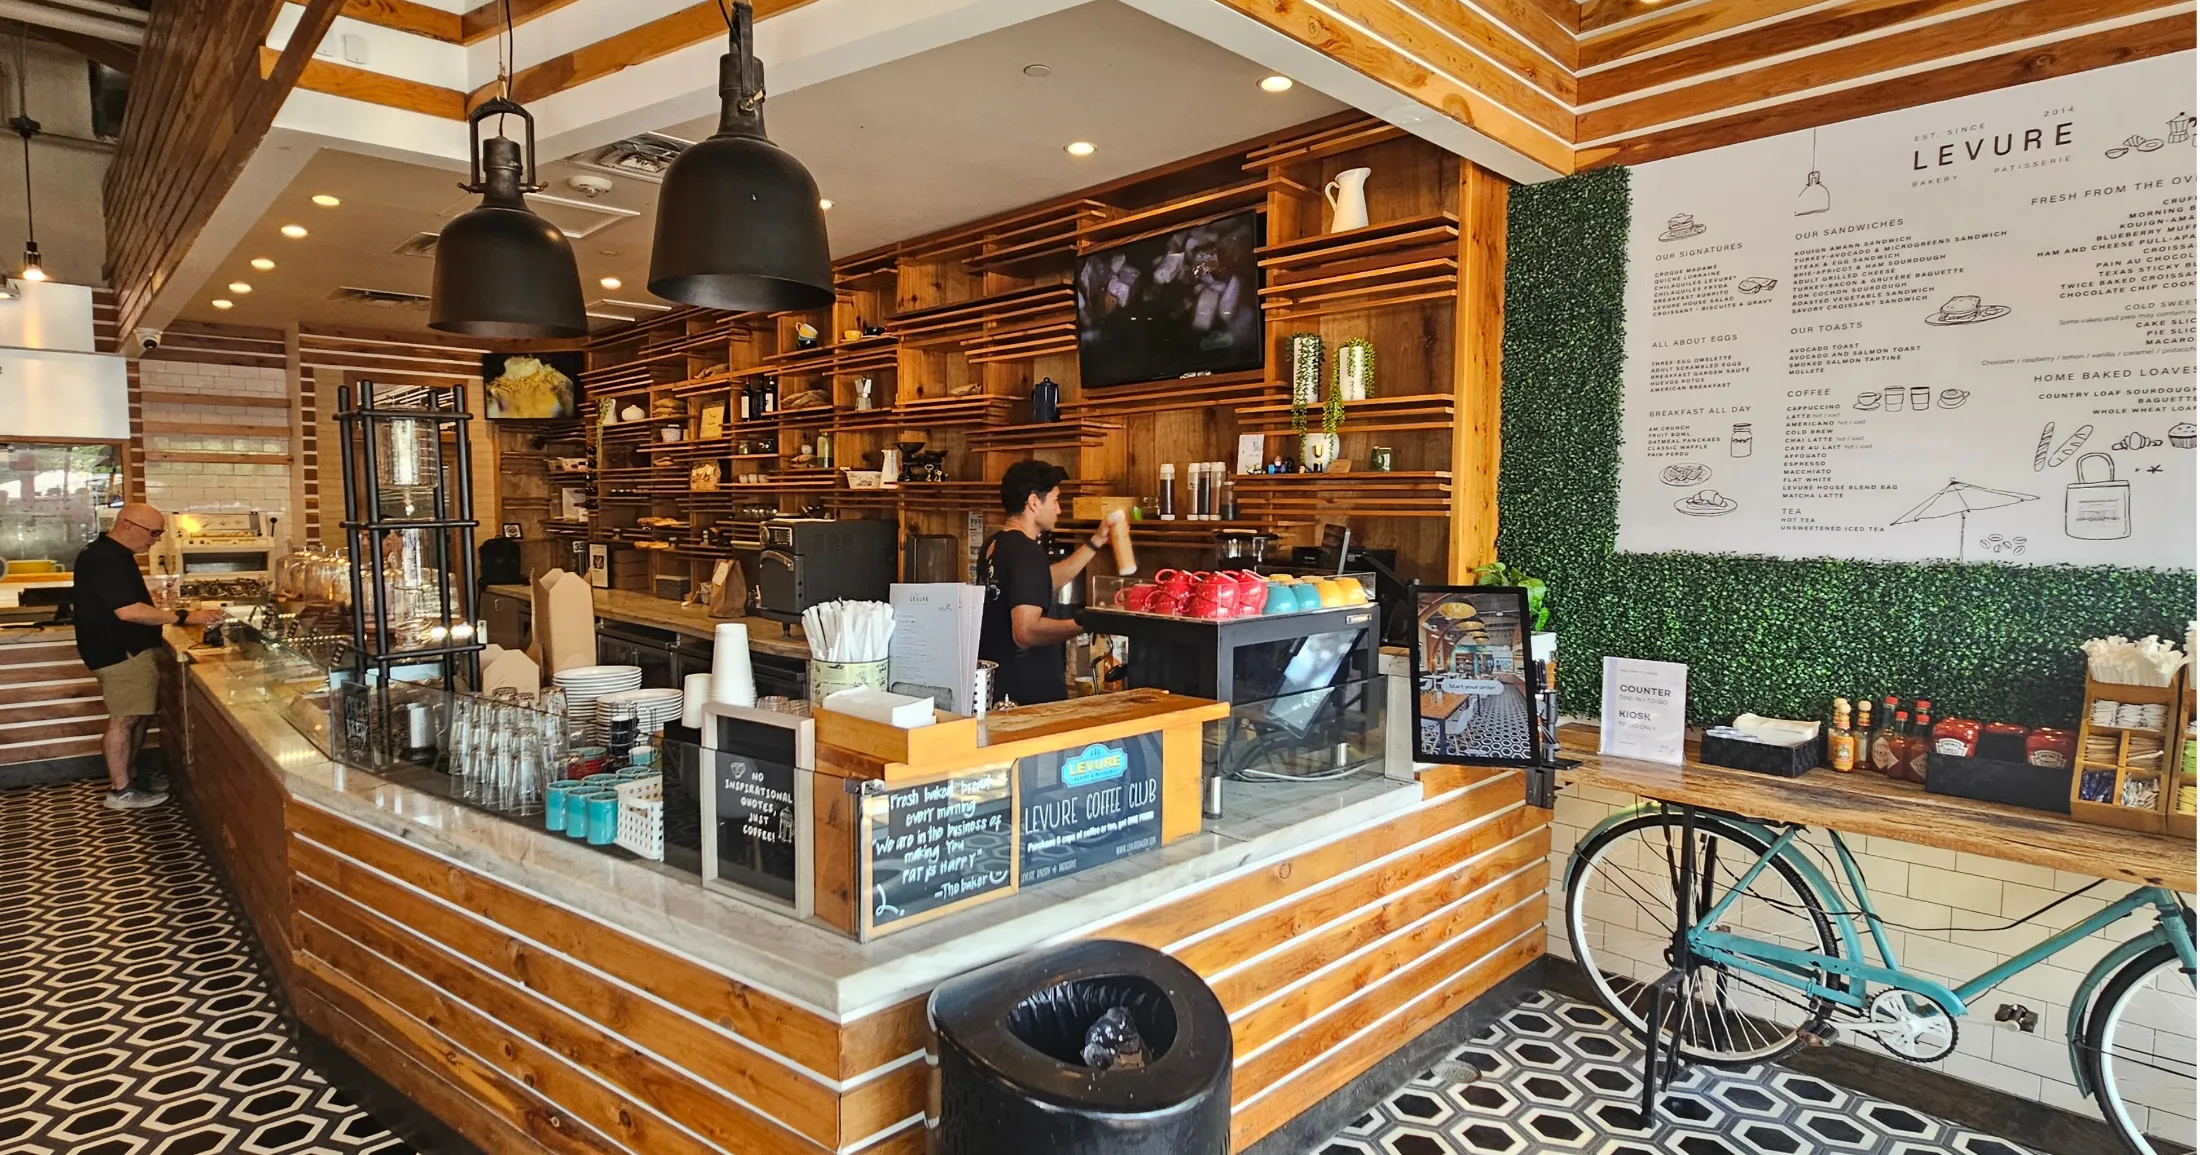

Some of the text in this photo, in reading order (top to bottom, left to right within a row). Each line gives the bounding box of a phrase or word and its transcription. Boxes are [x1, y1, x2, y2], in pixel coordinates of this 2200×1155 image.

[2044, 106, 2074, 117] 2014
[1947, 123, 1984, 136] SINCE
[1914, 122, 2073, 171] LEVURE
[1994, 155, 2070, 173] PATISSERIE
[1912, 175, 1958, 188] BAKERY
[2031, 175, 2197, 206] FRESH FROM THE OV
[1795, 218, 1904, 241] OUR SANDWICHES
[2096, 228, 2162, 241] BLUEBERRY
[1656, 242, 1742, 261] OUR SIGNATURES
[1794, 236, 1911, 256] KOUIGN AMANN SANDWICH
[2064, 246, 2087, 254] AND
[2091, 240, 2134, 251] CHEESE
[1654, 270, 1720, 285] QUICHE LORRAINE
[1655, 264, 1717, 278] CROQUE MADAME
[1793, 268, 1895, 285] ADULT GRILLED CHEESE
[1792, 286, 1934, 307] ROASTED VEGETABLE SANDWICH
[1813, 289, 1848, 297] COCHON
[1852, 282, 1907, 293] SOURDOUGH
[2060, 287, 2125, 299] CHOCOLATE
[2130, 284, 2158, 292] CHIP
[1653, 290, 1728, 304] BREAKFAST BURRITO
[1653, 296, 1734, 311] LEVURE HOUSE SALAD
[1792, 295, 1928, 314] SAVORY CROISSANT SANDWICH
[2125, 302, 2155, 311] COLD
[1791, 321, 1862, 335] OUR TOASTS
[1673, 337, 1706, 346] ABOUT
[1711, 334, 1737, 343] EGGS
[1789, 353, 1828, 361] AVOCADO
[1853, 348, 1888, 356] SALMON
[1893, 345, 1921, 353] TOAST
[1790, 342, 1859, 353] AVOCADO TOAST
[1694, 355, 1731, 363] OMELETTE
[1789, 360, 1822, 368] SMOKED
[1865, 354, 1901, 362] TARTINE
[1789, 367, 1824, 375] MOLLETE
[2034, 373, 2074, 383] HOME
[2082, 369, 2132, 380] BAKED
[1689, 382, 1730, 390] BREAKFAST
[1787, 388, 1830, 398] COFFEE
[2039, 392, 2089, 400] COUNTRY
[1649, 408, 1704, 418] BREAKFAST
[1732, 405, 1751, 413] DAY
[1787, 404, 1840, 412] CAPPUCCINO
[1620, 684, 1671, 697] COUNTER
[1619, 710, 1651, 721] KIOSK
[1069, 754, 1121, 776] LEVURE
[752, 772, 764, 782] NO
[725, 779, 793, 803] INSPIRATIONAL
[890, 789, 919, 810] Fresh
[924, 779, 953, 799] baked
[741, 797, 777, 817] QUOTES,
[937, 800, 976, 818] morning
[1025, 778, 1157, 835] LEVURE COFFEE CLUB
[748, 812, 769, 825] JUST
[743, 824, 775, 843] COFFEE!
[896, 834, 914, 850] are
[917, 830, 926, 845] in
[928, 825, 943, 842] the
[947, 818, 987, 838] business
[989, 815, 1002, 831] of
[904, 845, 940, 864] making
[961, 874, 988, 893] baker
